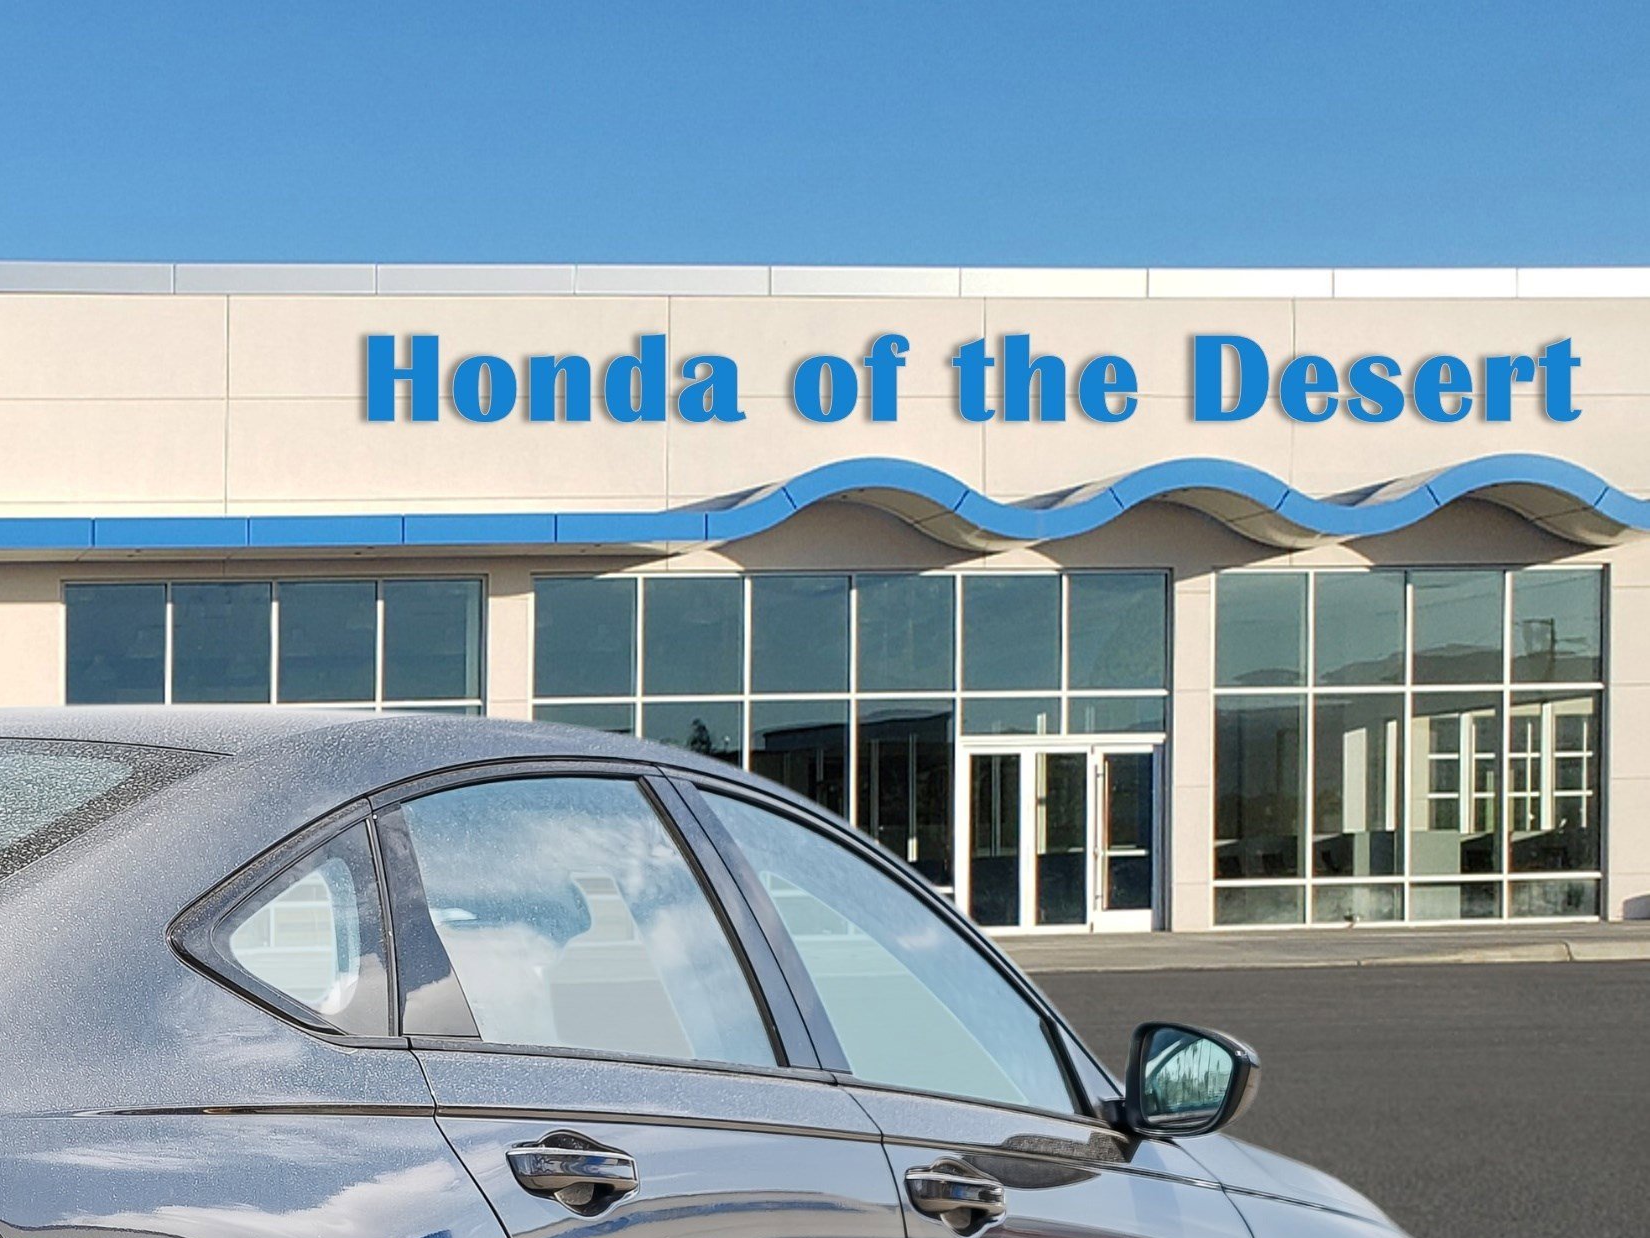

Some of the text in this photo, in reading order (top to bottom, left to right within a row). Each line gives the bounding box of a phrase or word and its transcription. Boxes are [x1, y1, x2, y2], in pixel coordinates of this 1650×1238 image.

[366, 333, 1583, 423] Honda of the Desert
